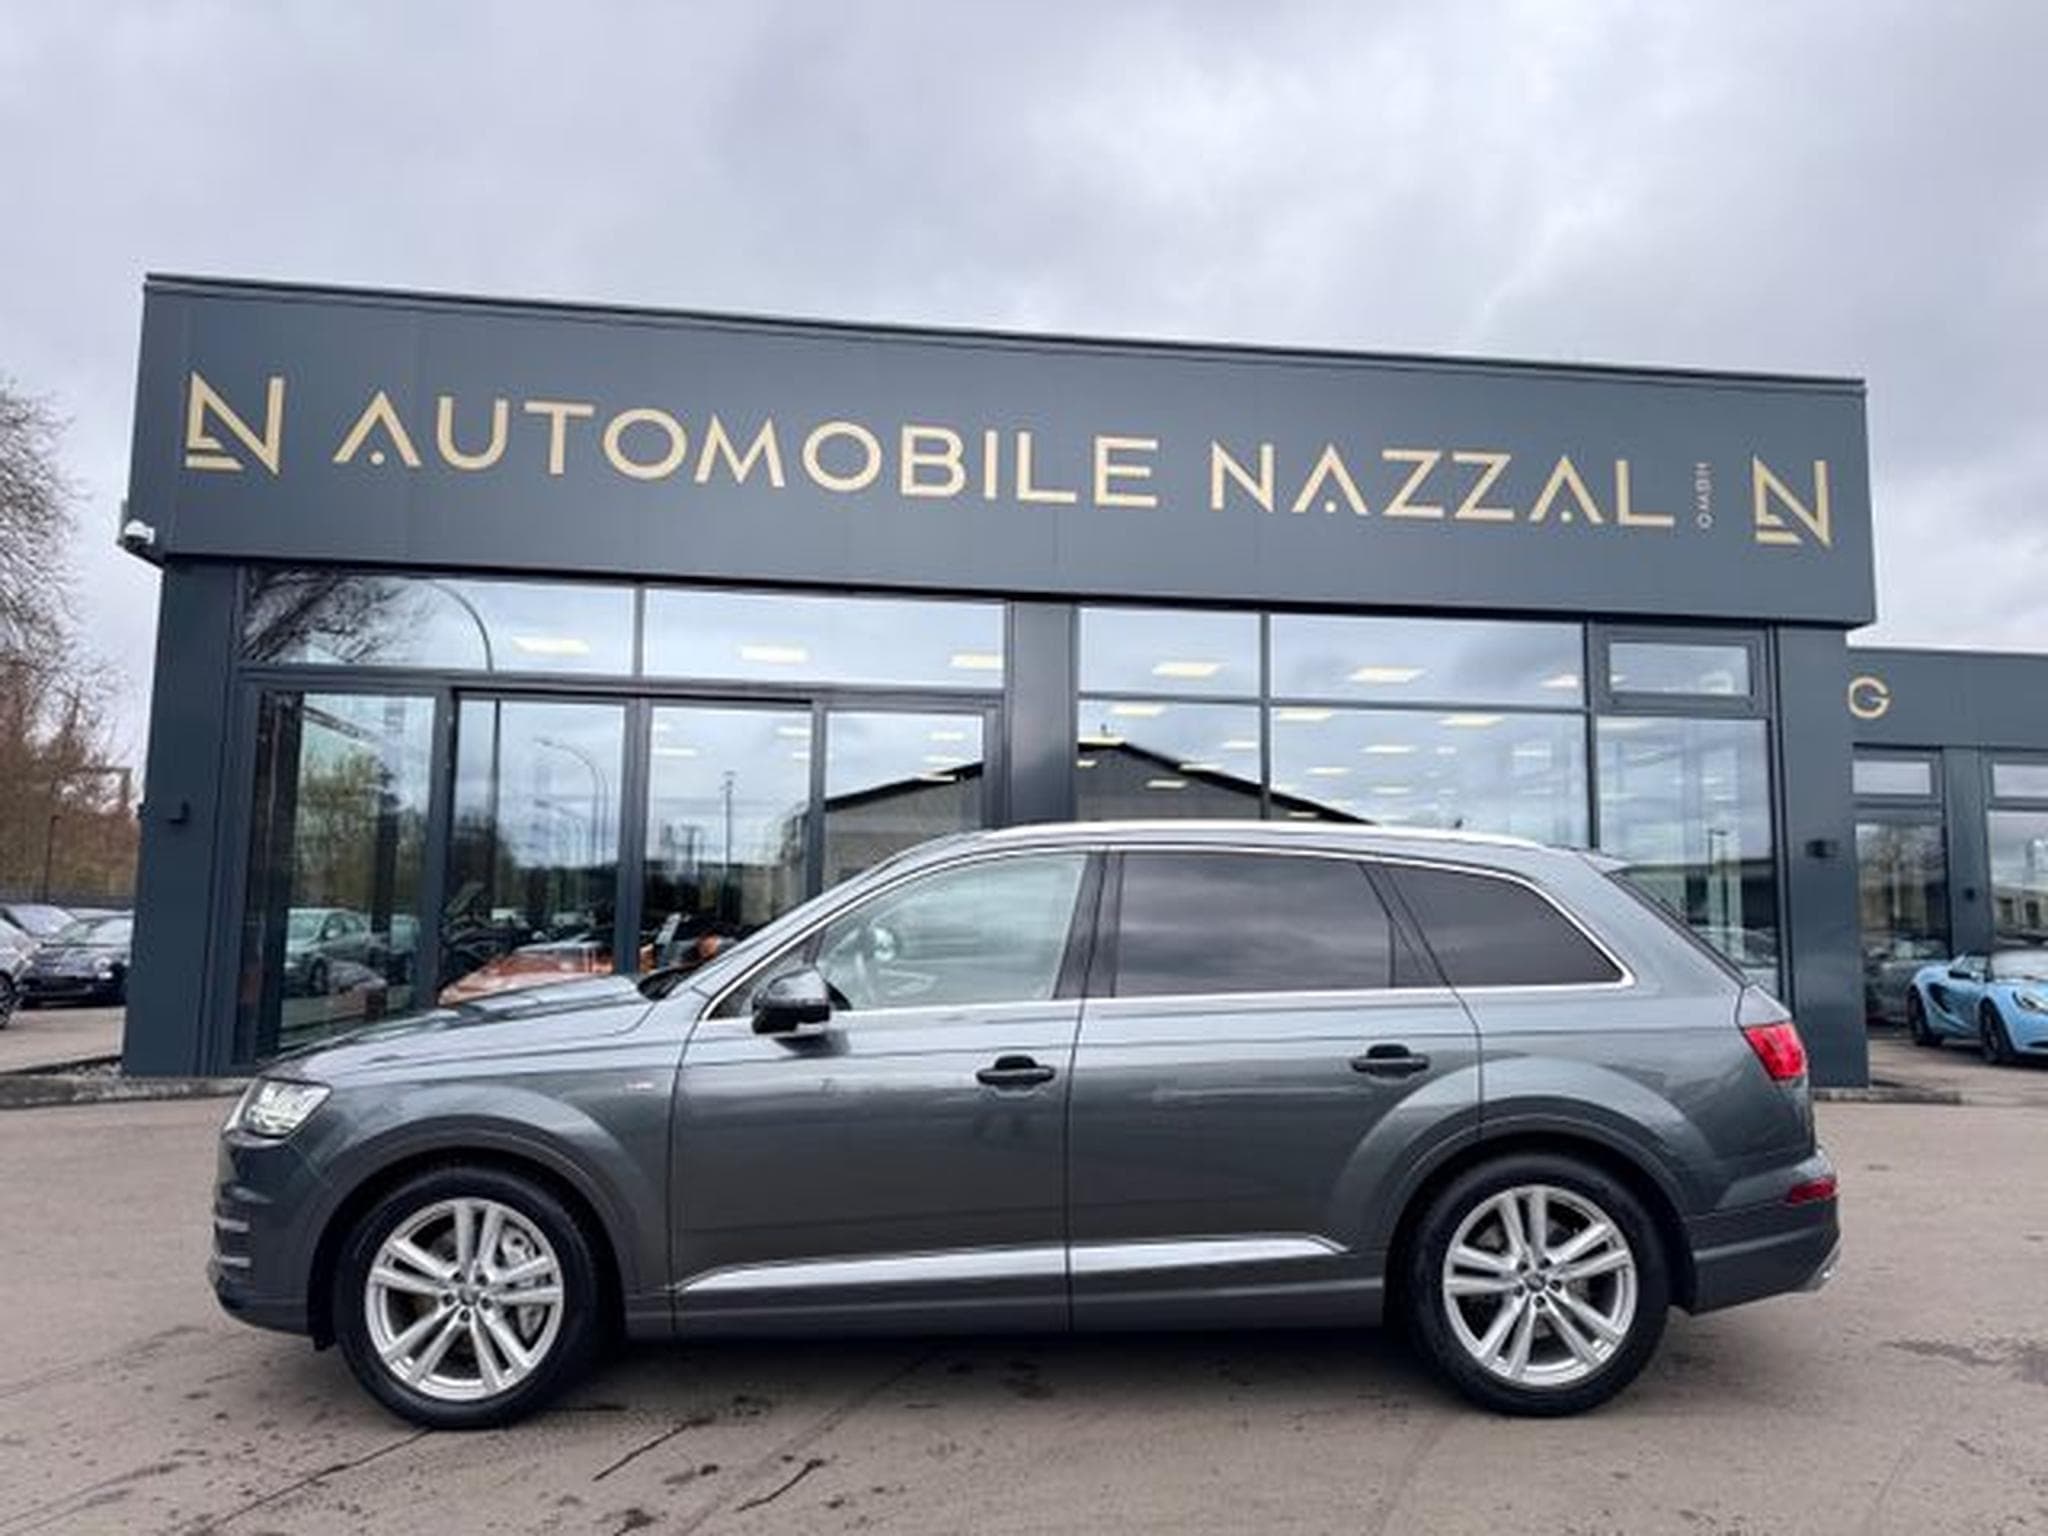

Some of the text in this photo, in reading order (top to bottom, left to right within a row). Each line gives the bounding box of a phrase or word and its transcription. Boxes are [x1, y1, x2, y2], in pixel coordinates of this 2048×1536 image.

[332, 390, 1675, 528] AUTOMOBILE NAZZAL
[1848, 676, 1890, 720] G
